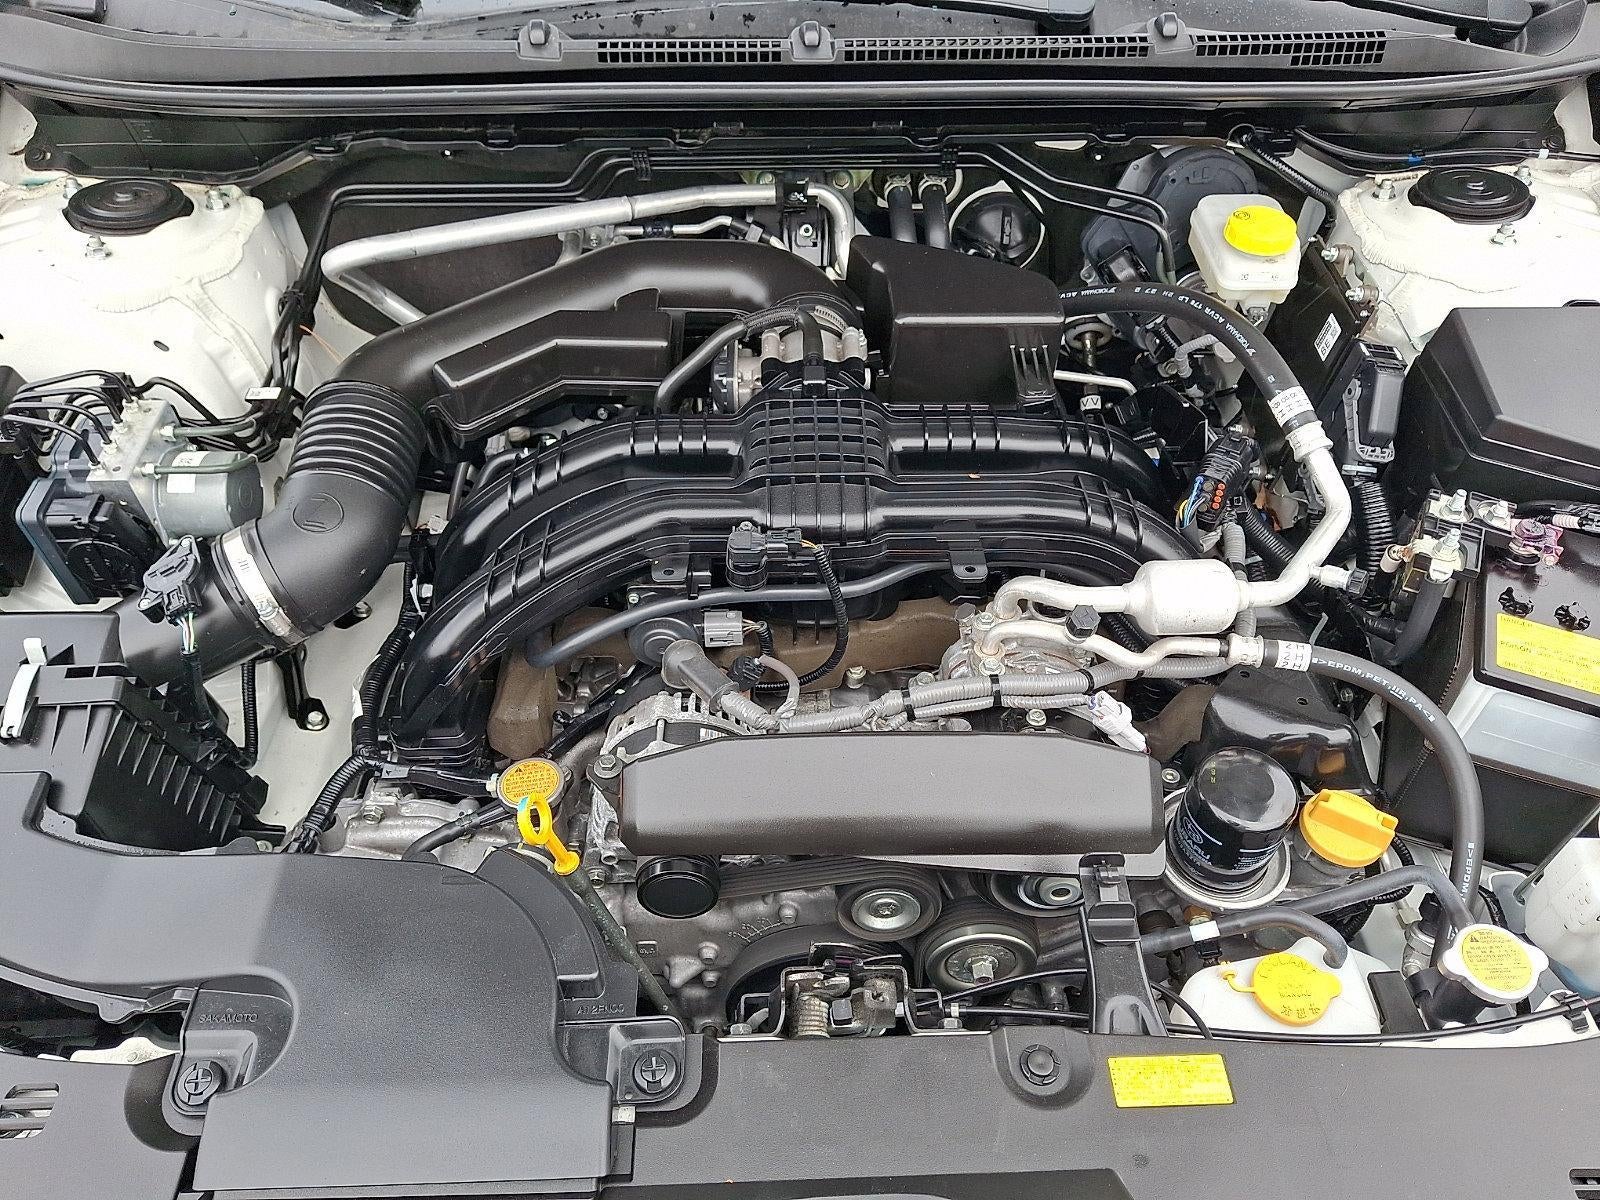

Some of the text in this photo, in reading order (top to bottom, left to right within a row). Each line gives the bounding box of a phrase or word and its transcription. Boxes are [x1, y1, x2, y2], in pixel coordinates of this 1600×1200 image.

[1059, 291, 1078, 299] ACV
[1225, 322, 1251, 350] YOKOHAMA
[198, 1013, 259, 1024] SAKAMOTO
